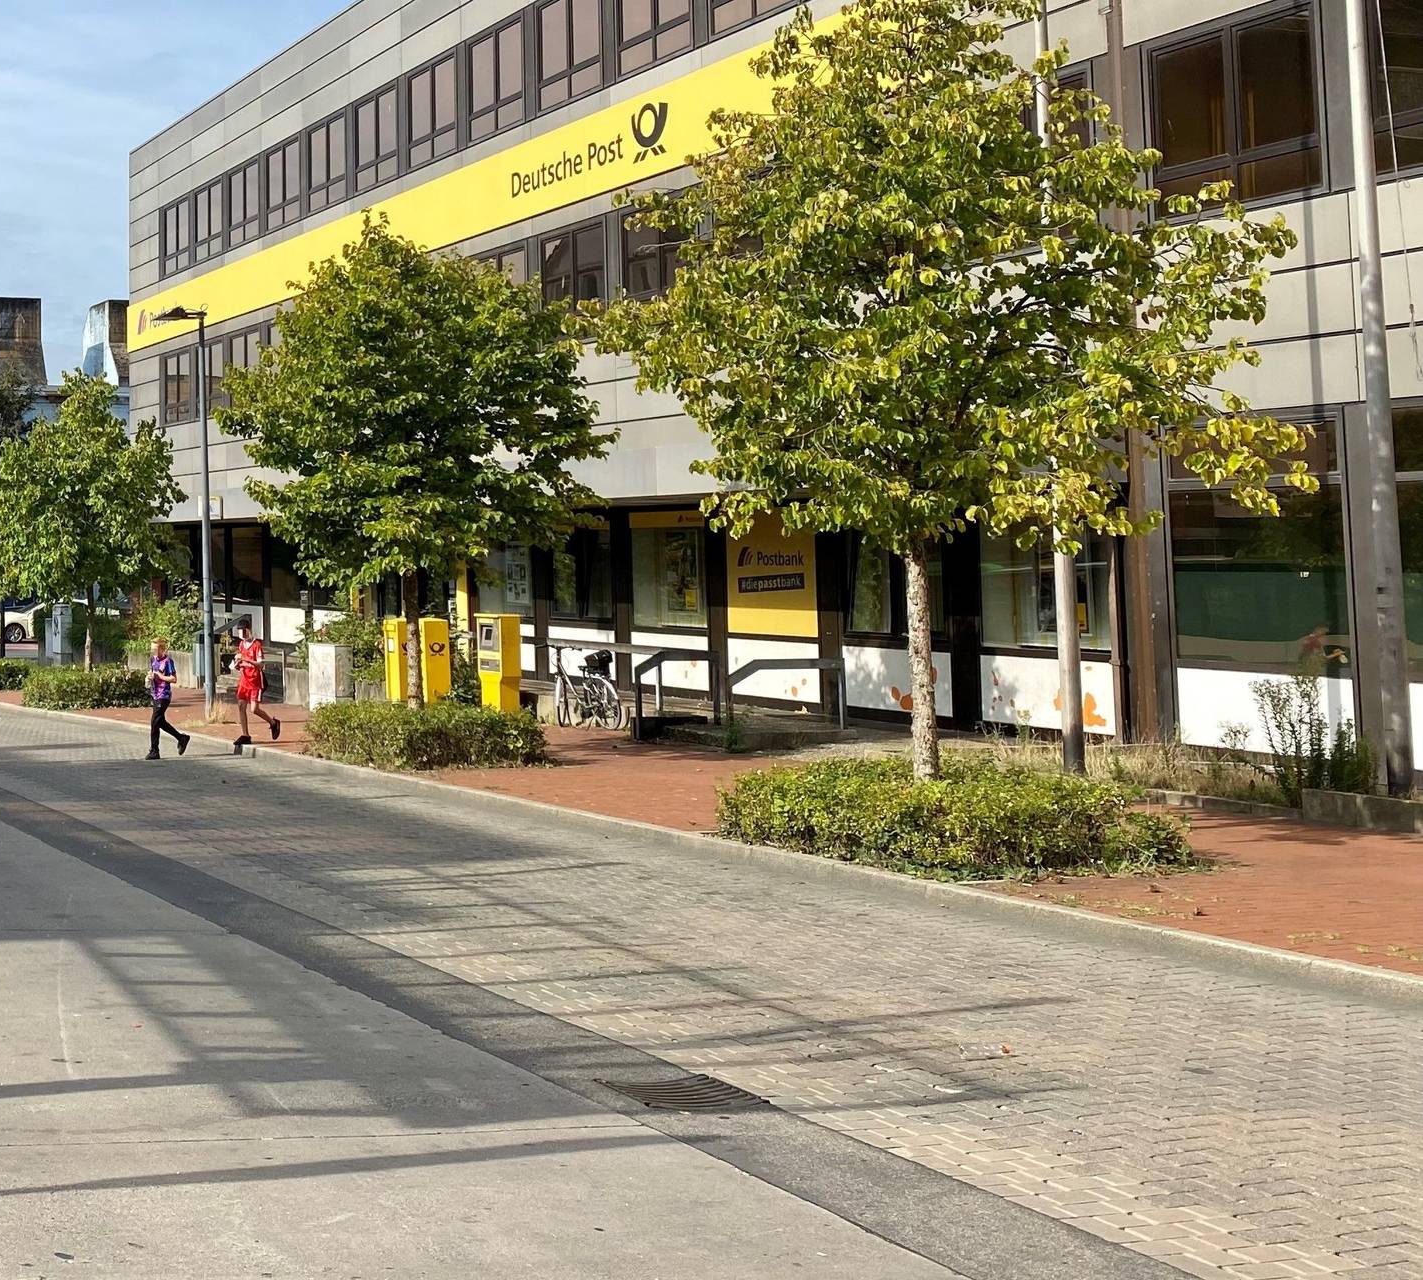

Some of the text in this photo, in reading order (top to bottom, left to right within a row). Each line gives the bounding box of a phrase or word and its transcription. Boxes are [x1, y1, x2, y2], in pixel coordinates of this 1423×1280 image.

[511, 133, 624, 199] Deutsche Post
[757, 549, 805, 567] Postbank
[740, 575, 802, 592] #diepasstbank
